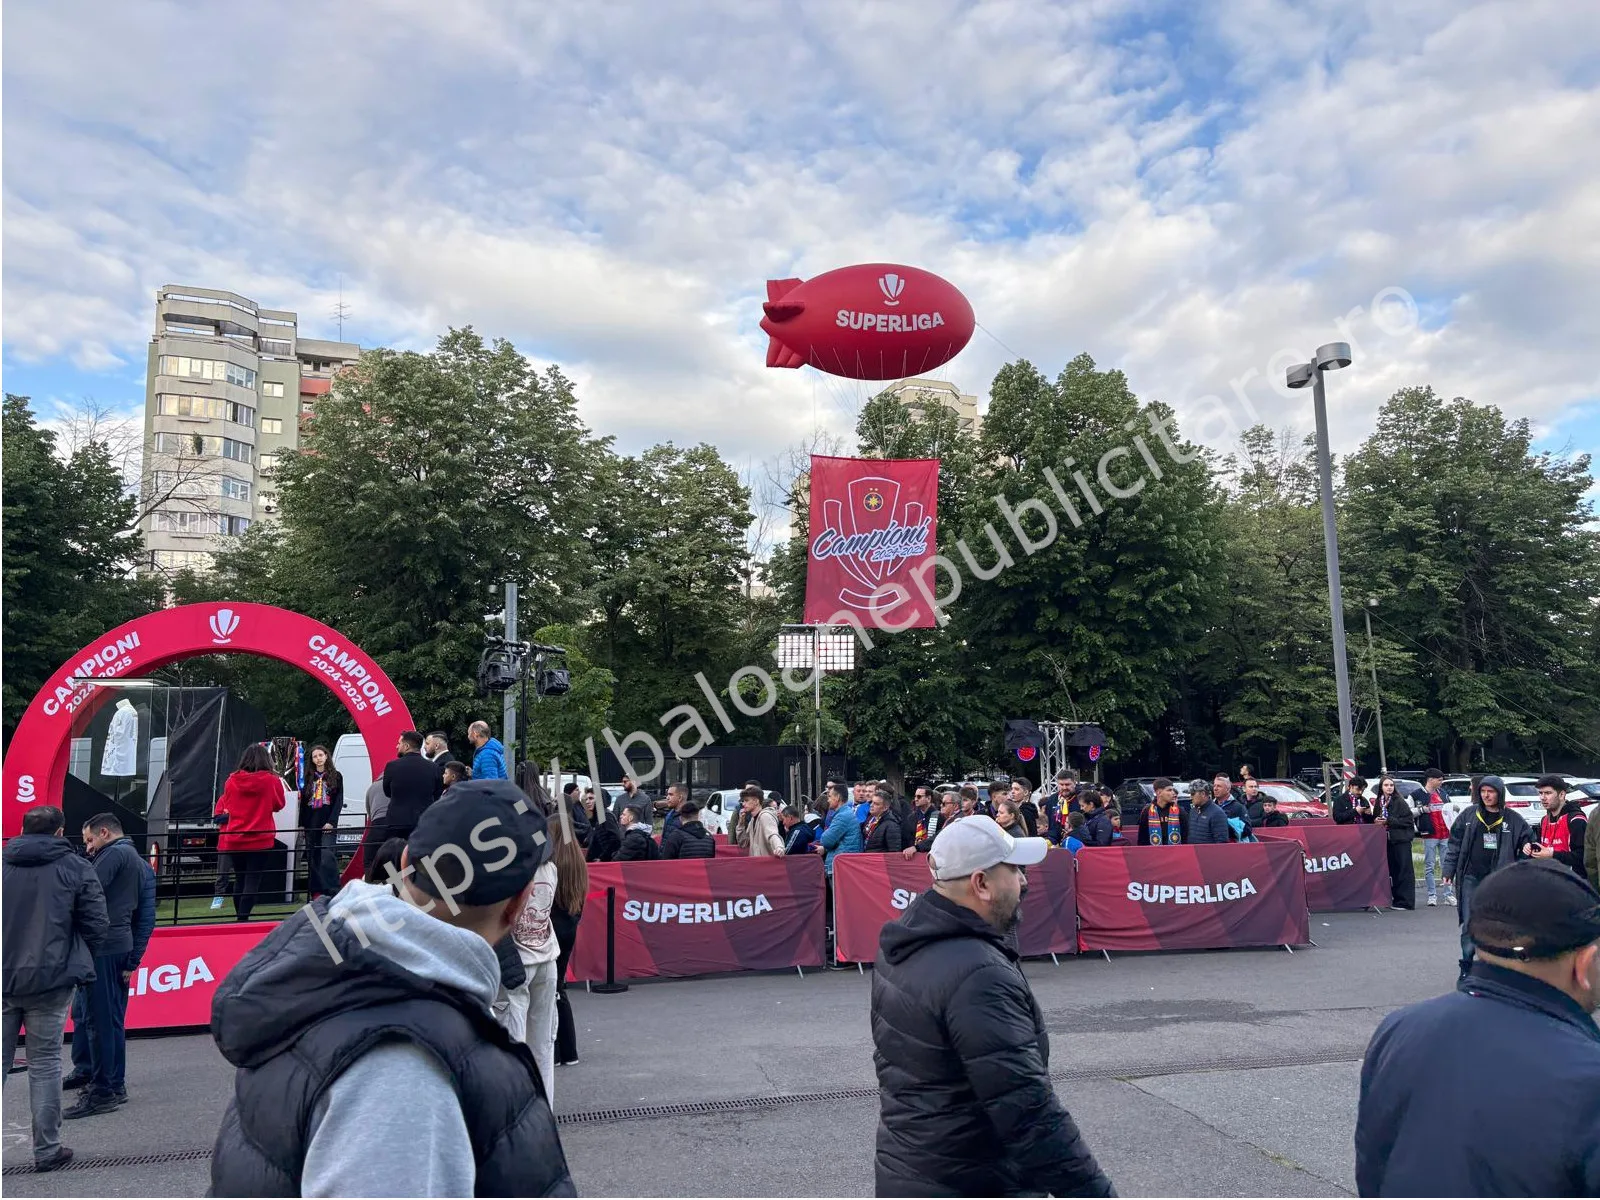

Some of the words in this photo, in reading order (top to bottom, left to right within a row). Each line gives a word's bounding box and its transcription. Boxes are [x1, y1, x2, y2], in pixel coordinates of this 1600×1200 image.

[836, 309, 944, 333] SUPERLIGA
[812, 516, 932, 562] Campioni
[871, 542, 928, 562] 2024-2025
[43, 631, 141, 715] CAMPIONI
[65, 656, 132, 713] 20242025
[308, 635, 392, 717] CAMPIONI
[309, 656, 367, 711] 2024-2025
[622, 893, 773, 924] SUPERLIGA
[890, 888, 917, 910] S
[1126, 877, 1257, 904] SUPERLIGA
[128, 956, 215, 997] IGA
